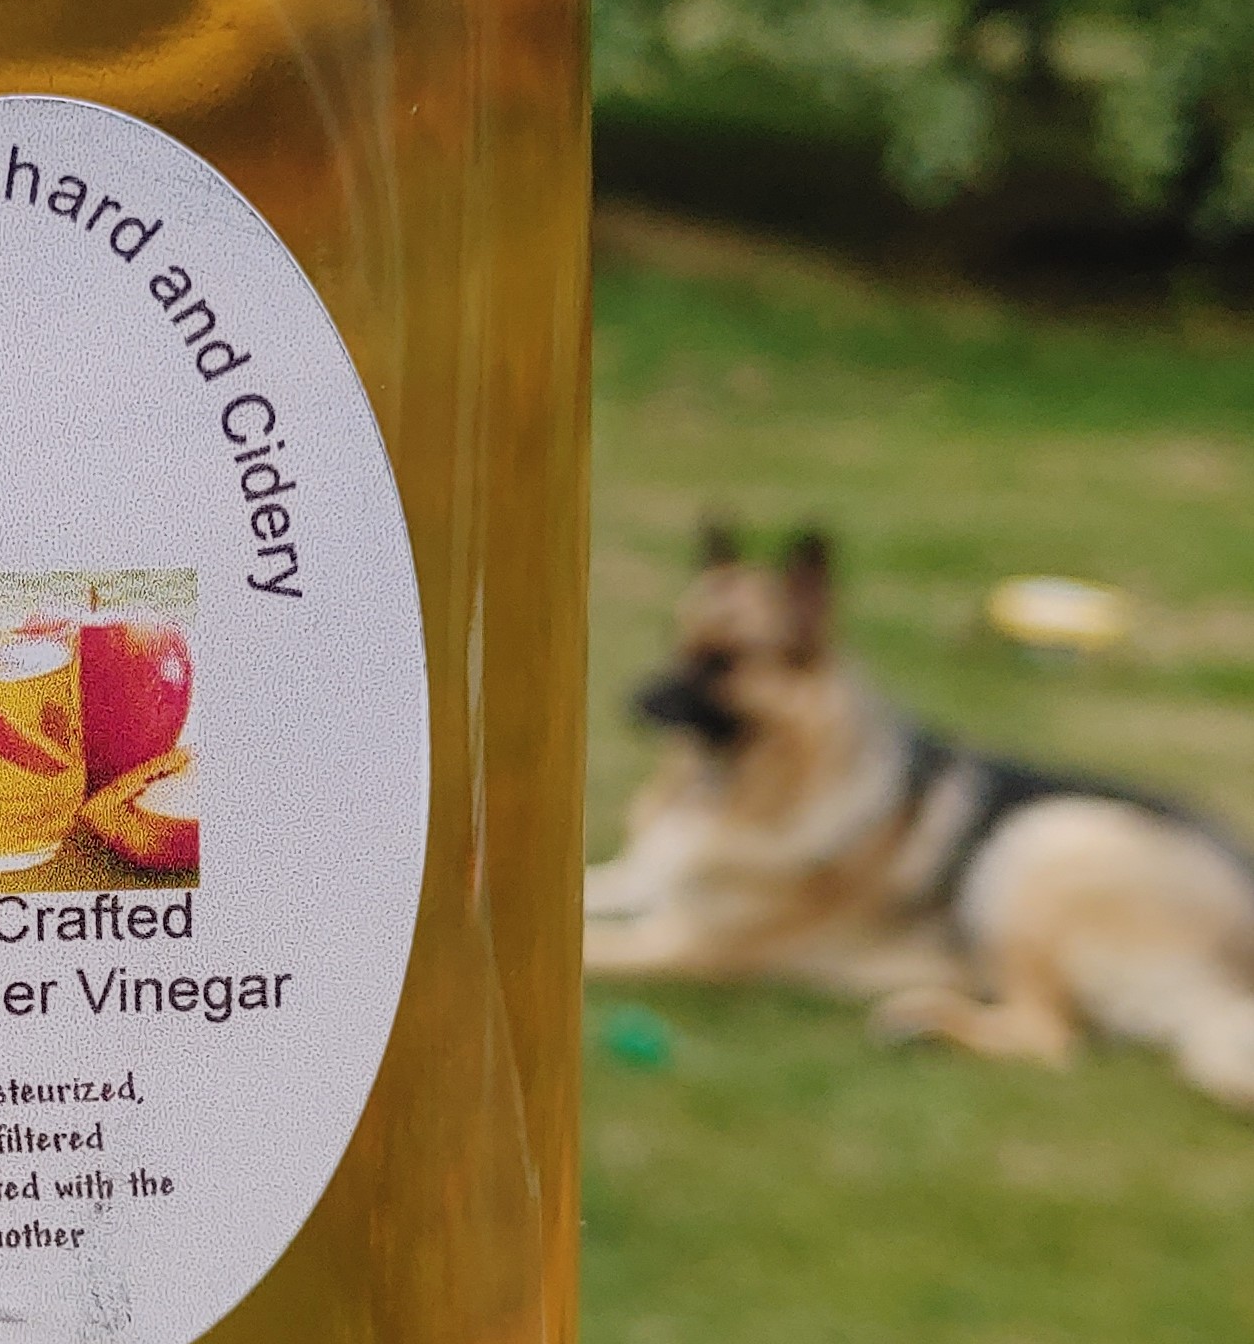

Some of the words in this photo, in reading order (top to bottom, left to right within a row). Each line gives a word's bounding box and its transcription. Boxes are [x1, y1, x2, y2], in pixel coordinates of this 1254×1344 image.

[149, 264, 252, 382] and
[221, 392, 304, 599] Cidery
[76, 967, 292, 1024] Vinegar
[54, 1170, 115, 1199] with
[128, 1167, 176, 1198] the
